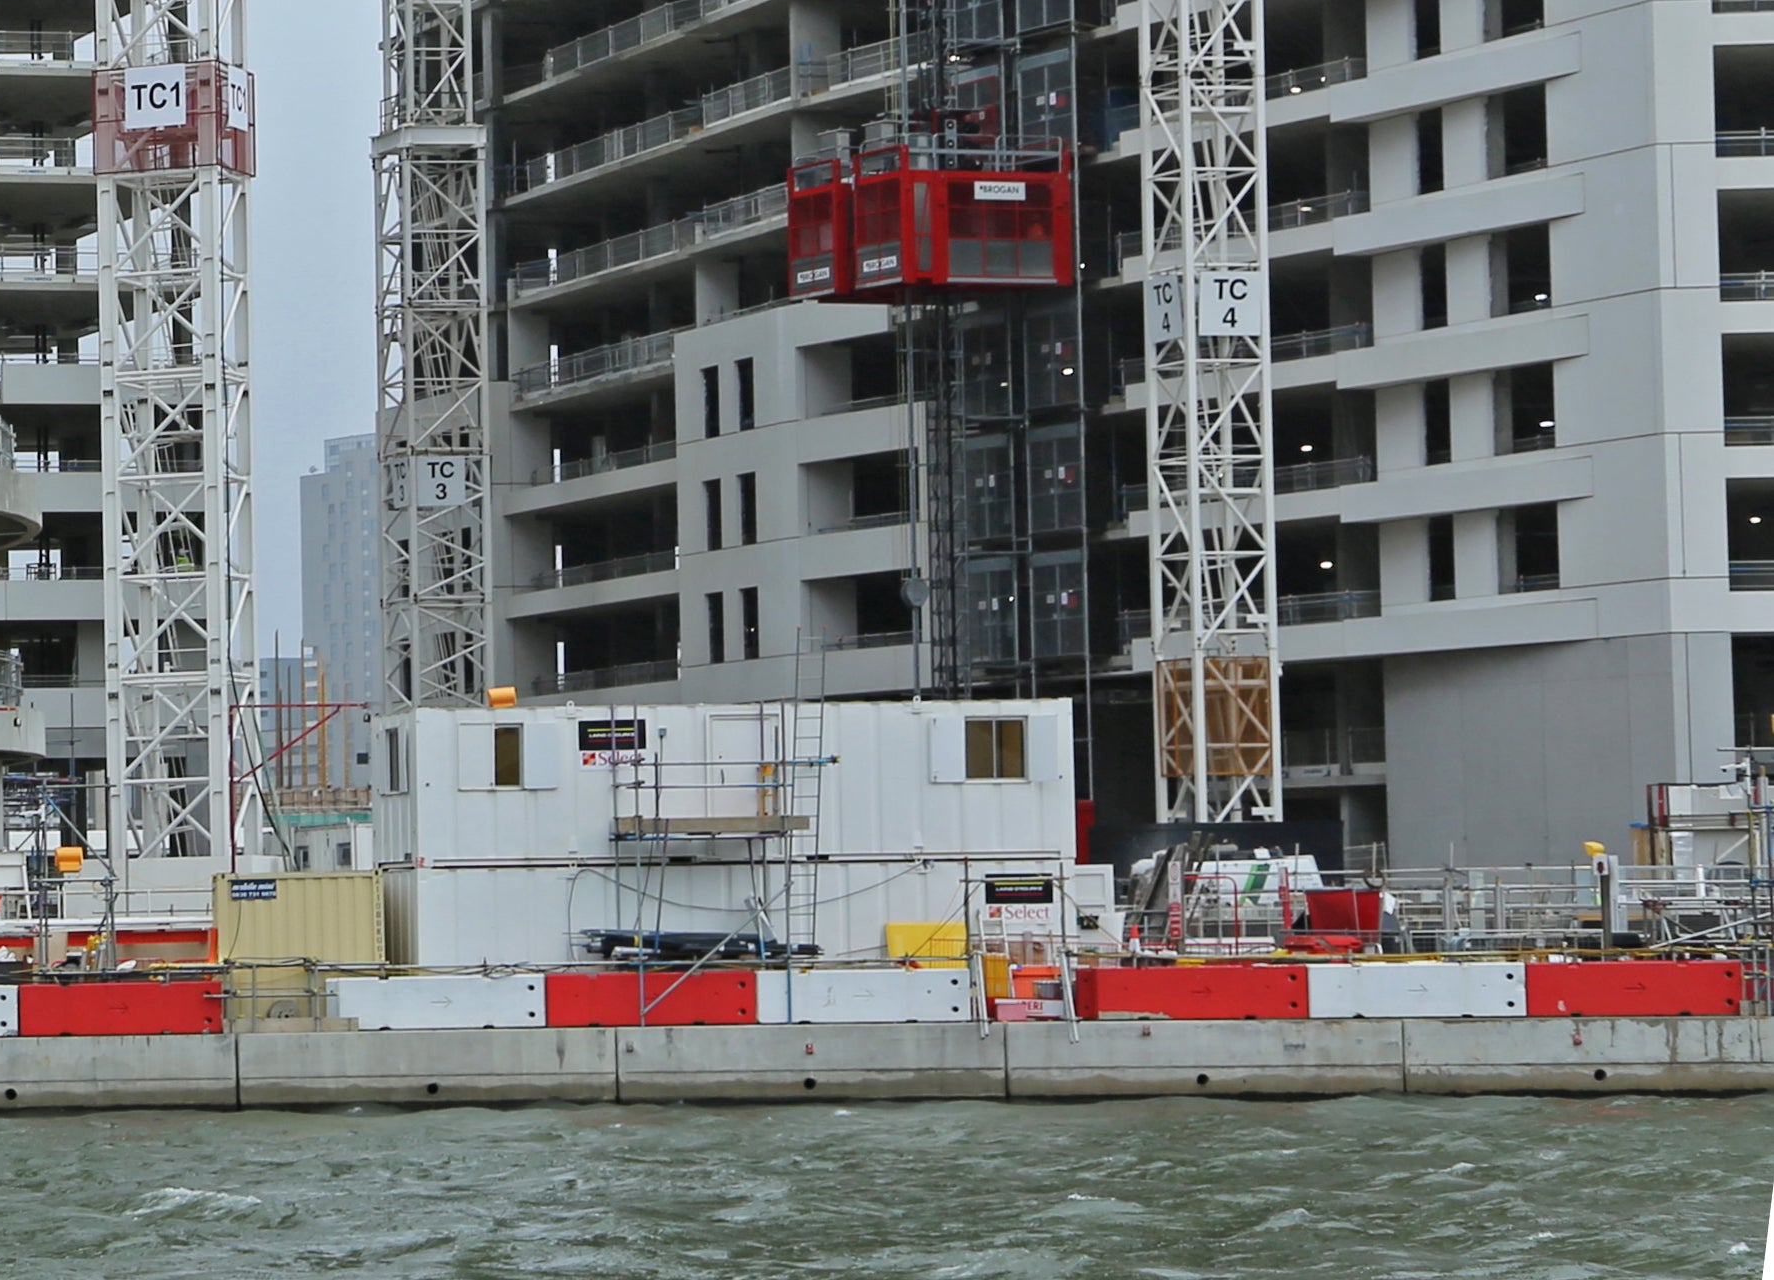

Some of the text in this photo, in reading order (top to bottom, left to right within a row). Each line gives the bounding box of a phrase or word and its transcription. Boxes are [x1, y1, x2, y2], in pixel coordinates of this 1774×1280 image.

[130, 81, 181, 111] TC1
[230, 83, 247, 113] TC1
[983, 185, 1020, 194] BROGAN
[1153, 282, 1173, 306] TC
[1213, 278, 1248, 300] TC
[1162, 312, 1171, 333] 4
[1222, 307, 1237, 328] 4
[394, 462, 406, 481] TC
[427, 461, 455, 479] TC
[435, 483, 447, 500] 3
[1004, 905, 1050, 920] Select
